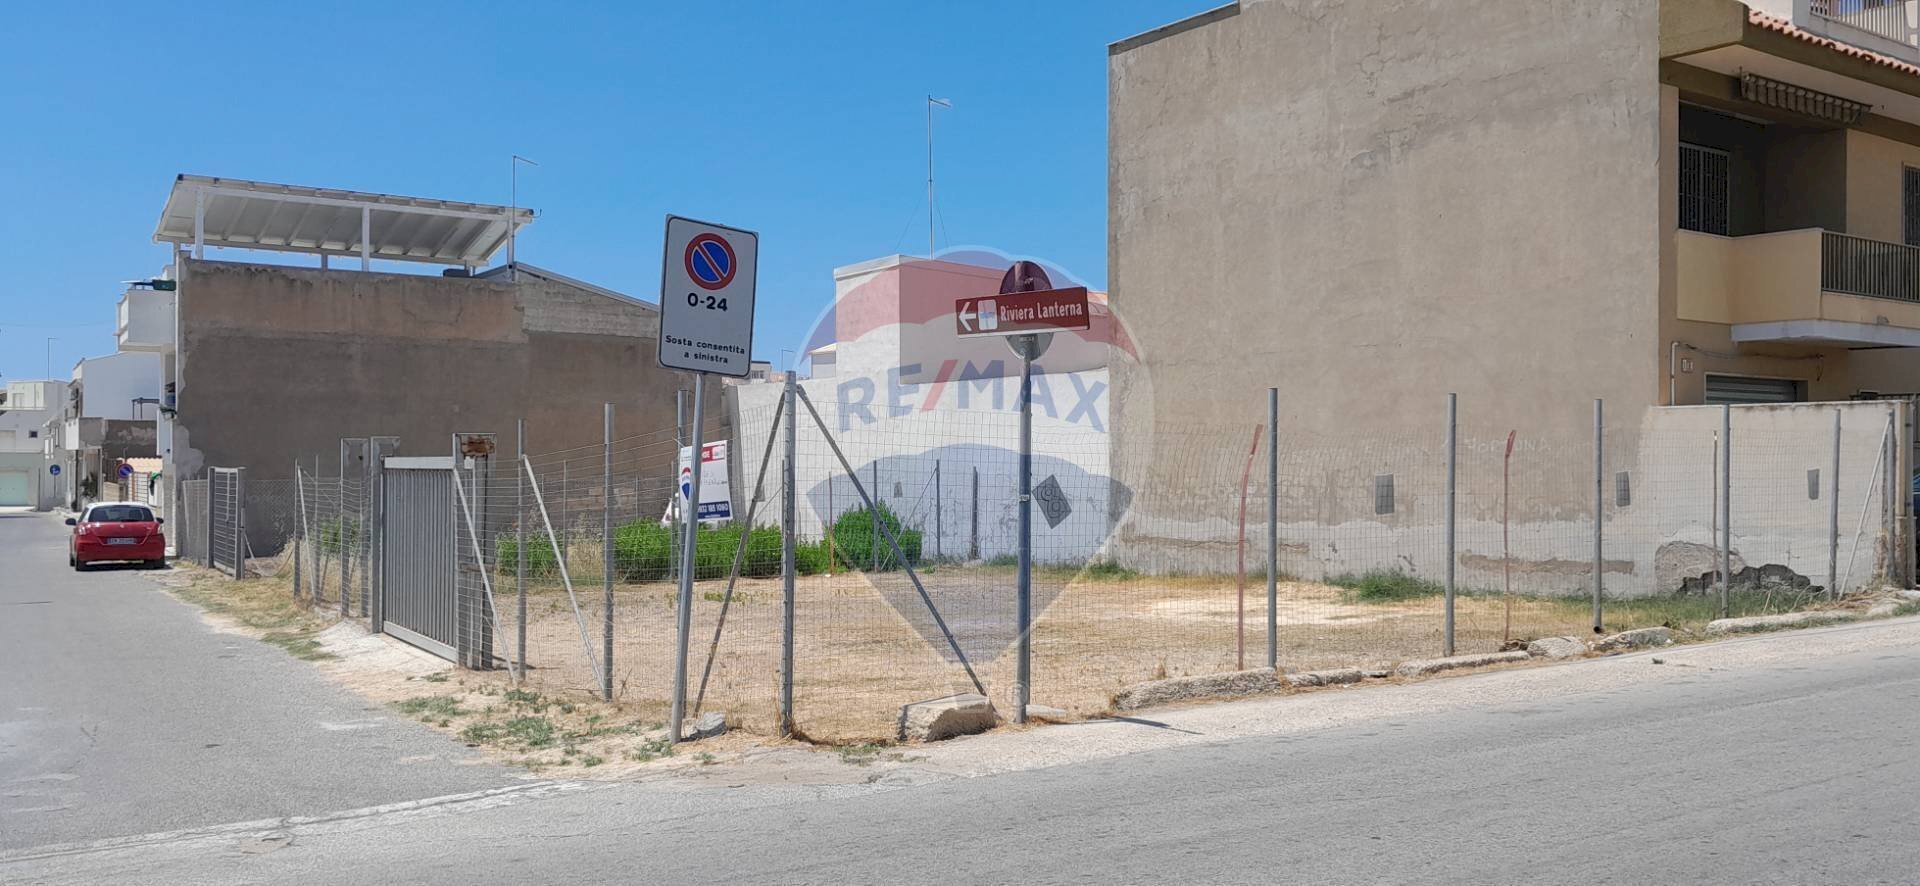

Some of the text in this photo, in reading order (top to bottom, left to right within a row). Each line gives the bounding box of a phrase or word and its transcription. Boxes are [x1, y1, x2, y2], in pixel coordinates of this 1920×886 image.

[687, 292, 728, 312] 0-24
[1000, 301, 1083, 322] Riviera Lanterna
[665, 335, 745, 354] Sosta consentita
[693, 352, 729, 364] sinistra
